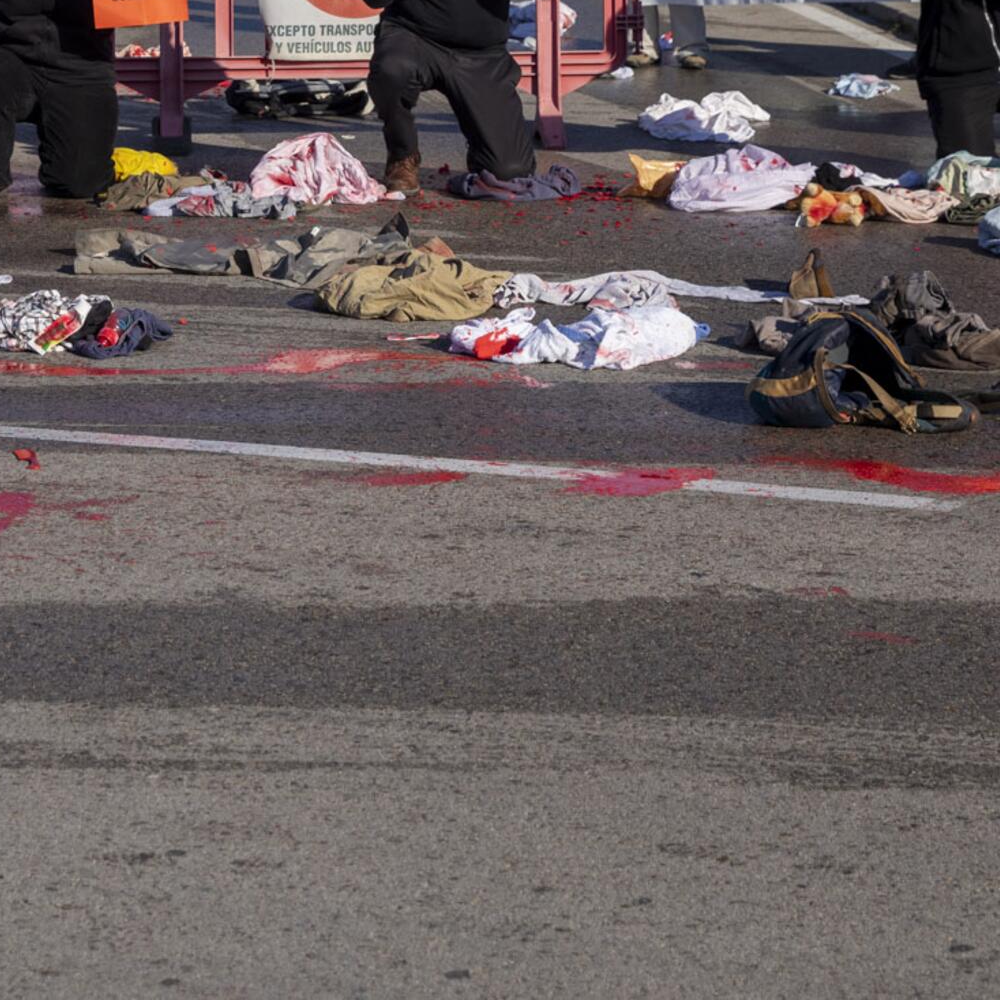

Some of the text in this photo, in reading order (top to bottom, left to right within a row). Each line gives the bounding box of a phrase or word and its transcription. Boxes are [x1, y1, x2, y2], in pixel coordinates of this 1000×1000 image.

[275, 38, 374, 54] Y VEHÍCULOS AU
